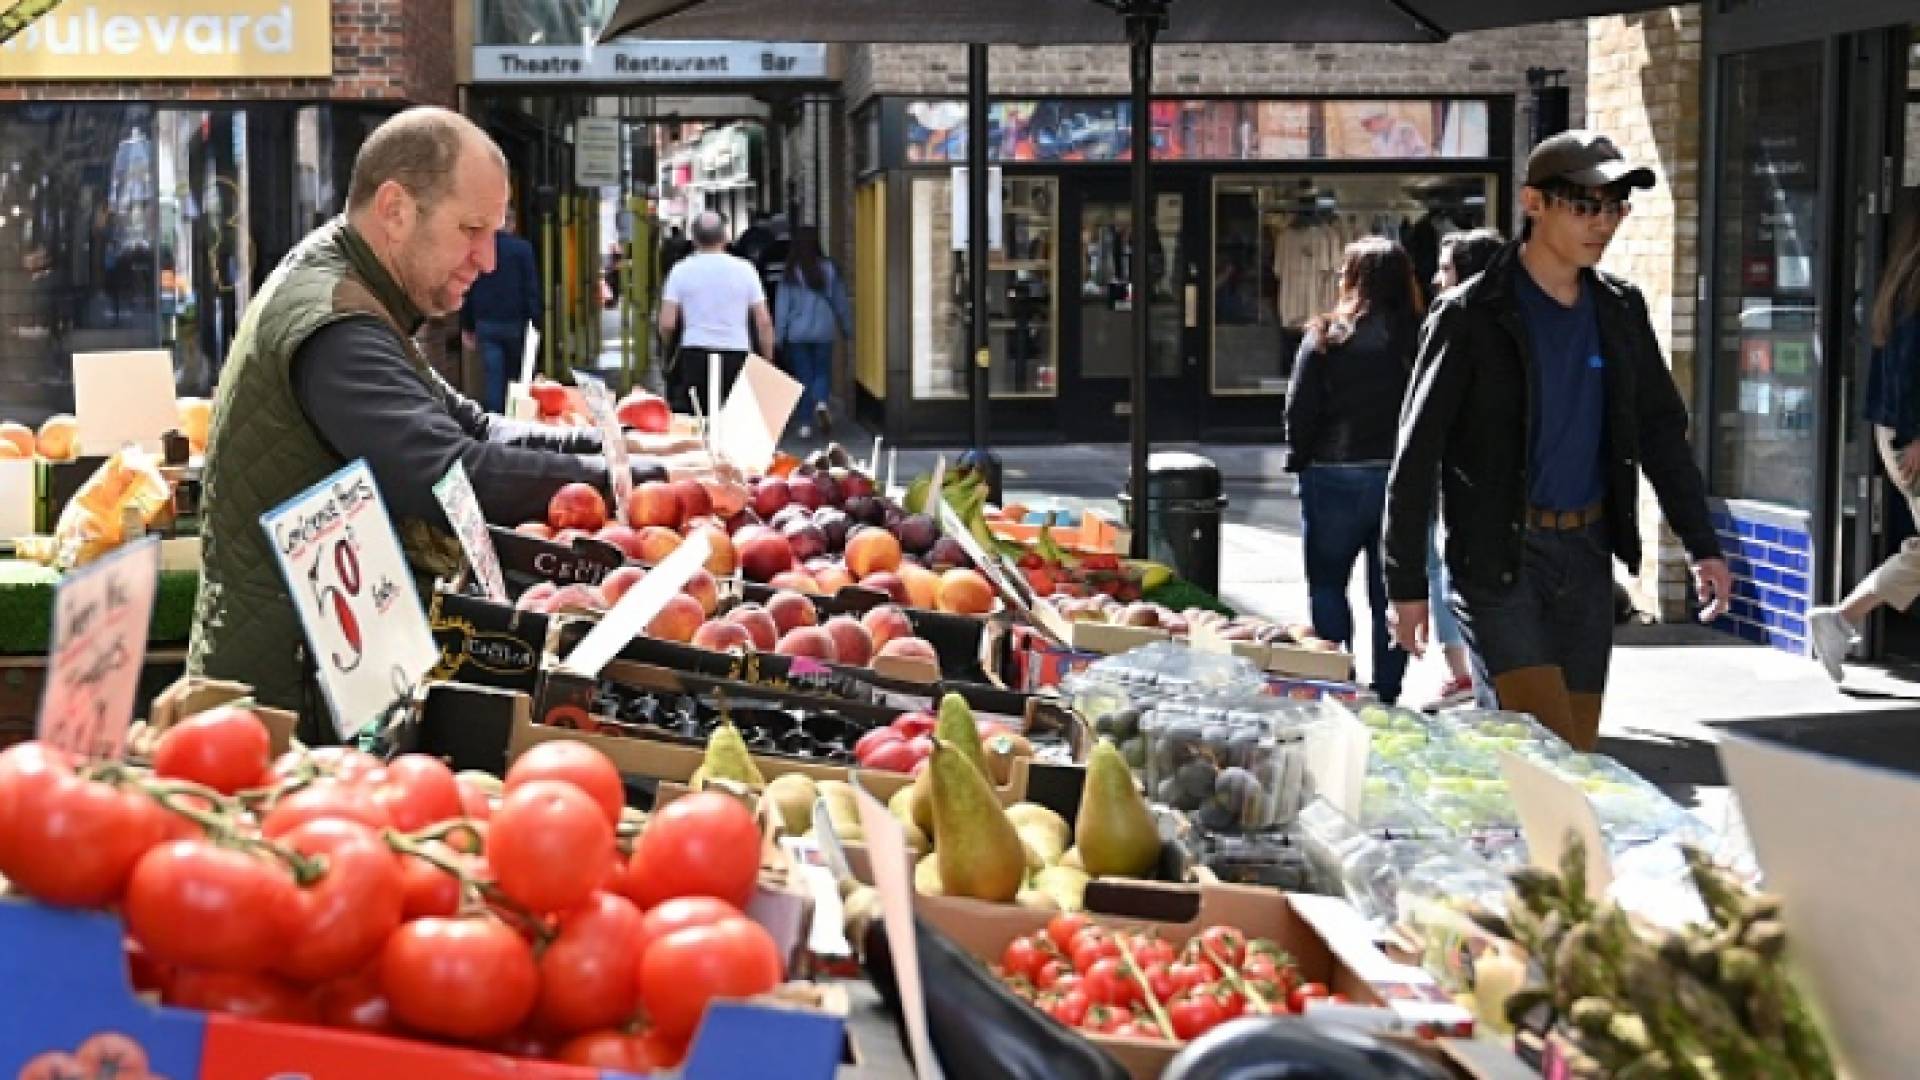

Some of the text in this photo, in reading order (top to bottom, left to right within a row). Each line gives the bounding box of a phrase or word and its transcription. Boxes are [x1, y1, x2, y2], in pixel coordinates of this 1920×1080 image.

[500, 52, 798, 74] Theatre Restaurant Bar
